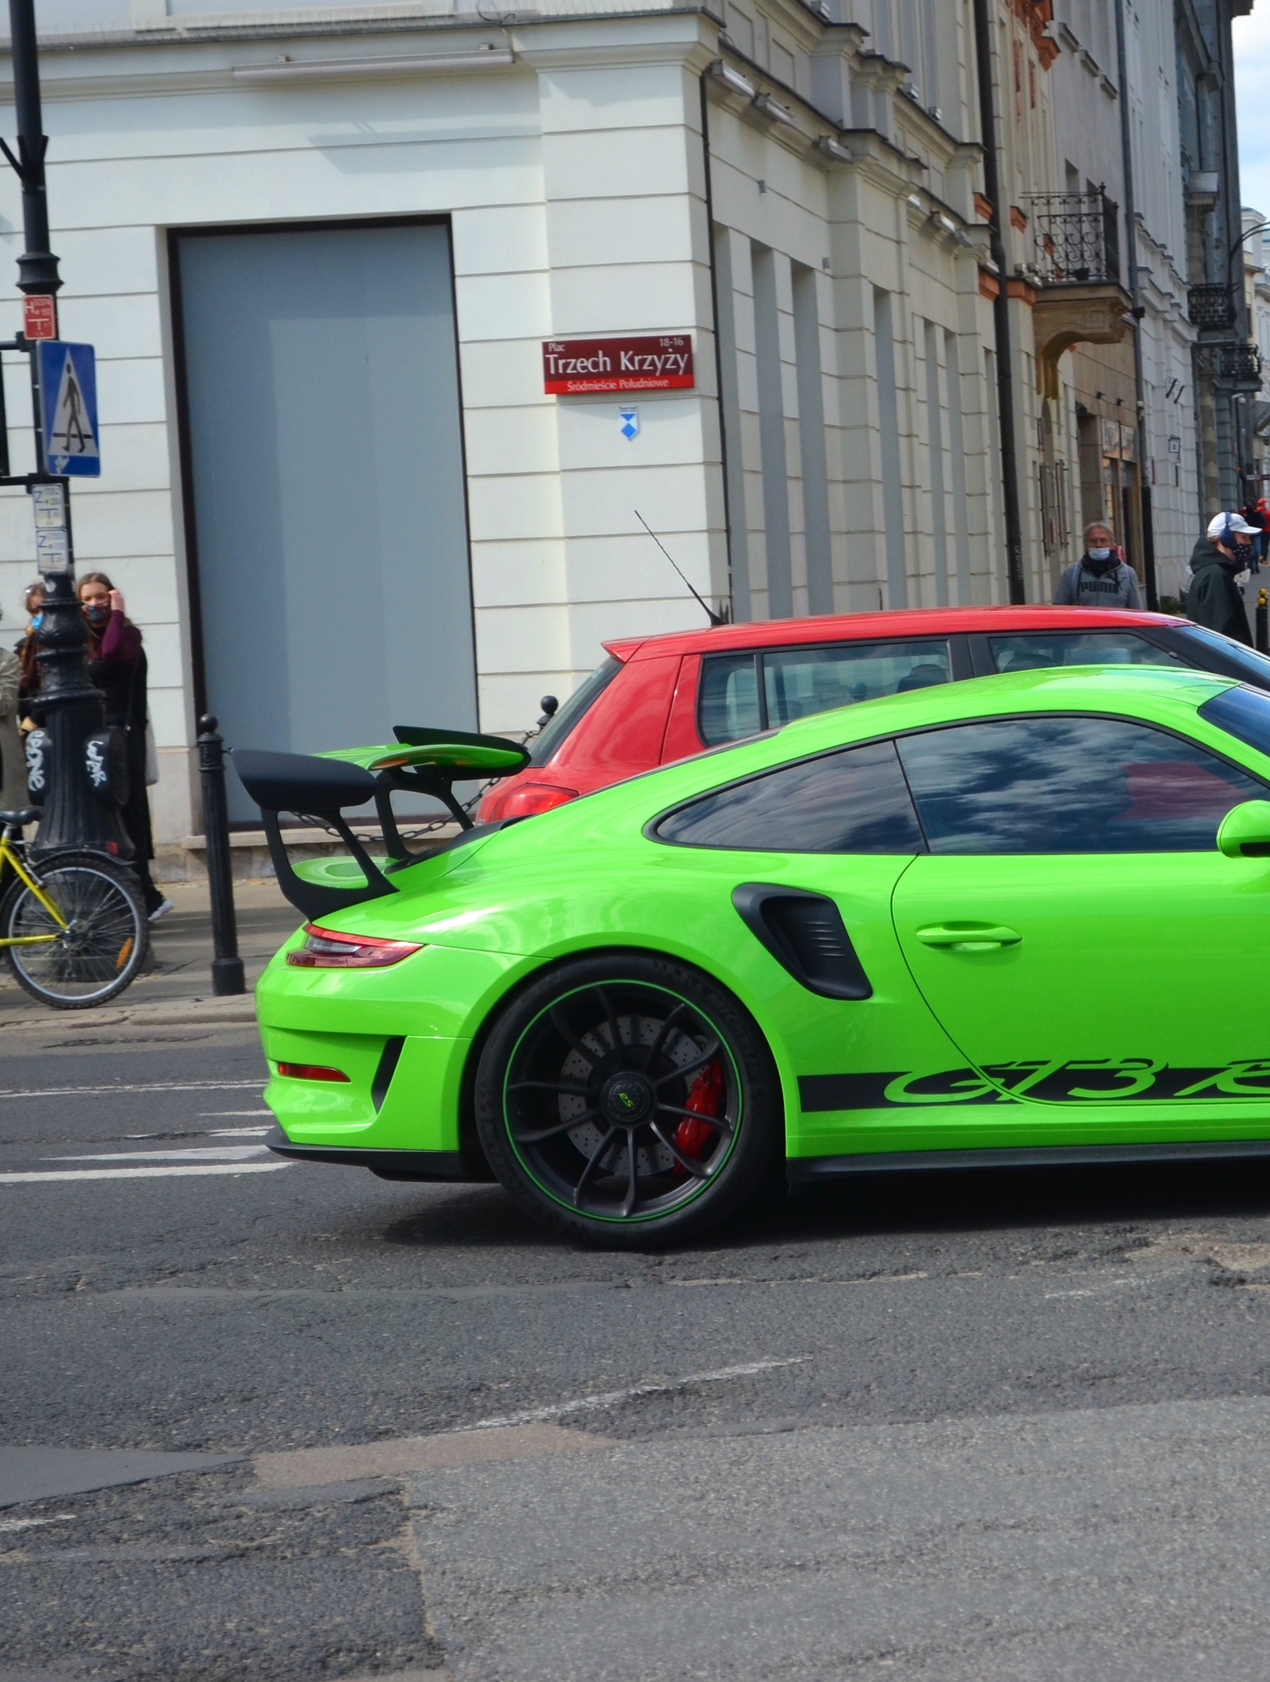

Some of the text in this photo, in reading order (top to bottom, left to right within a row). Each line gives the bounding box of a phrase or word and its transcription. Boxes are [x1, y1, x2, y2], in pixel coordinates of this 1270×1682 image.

[548, 343, 566, 352] Plac
[659, 338, 684, 347] 18-16
[545, 348, 688, 376] Trzech Krzyży
[567, 378, 669, 392] Śródmieście Południowe
[1081, 581, 1119, 595] PUMA
[884, 1058, 1168, 1104] GT3
[618, 1092, 633, 1108] RS
